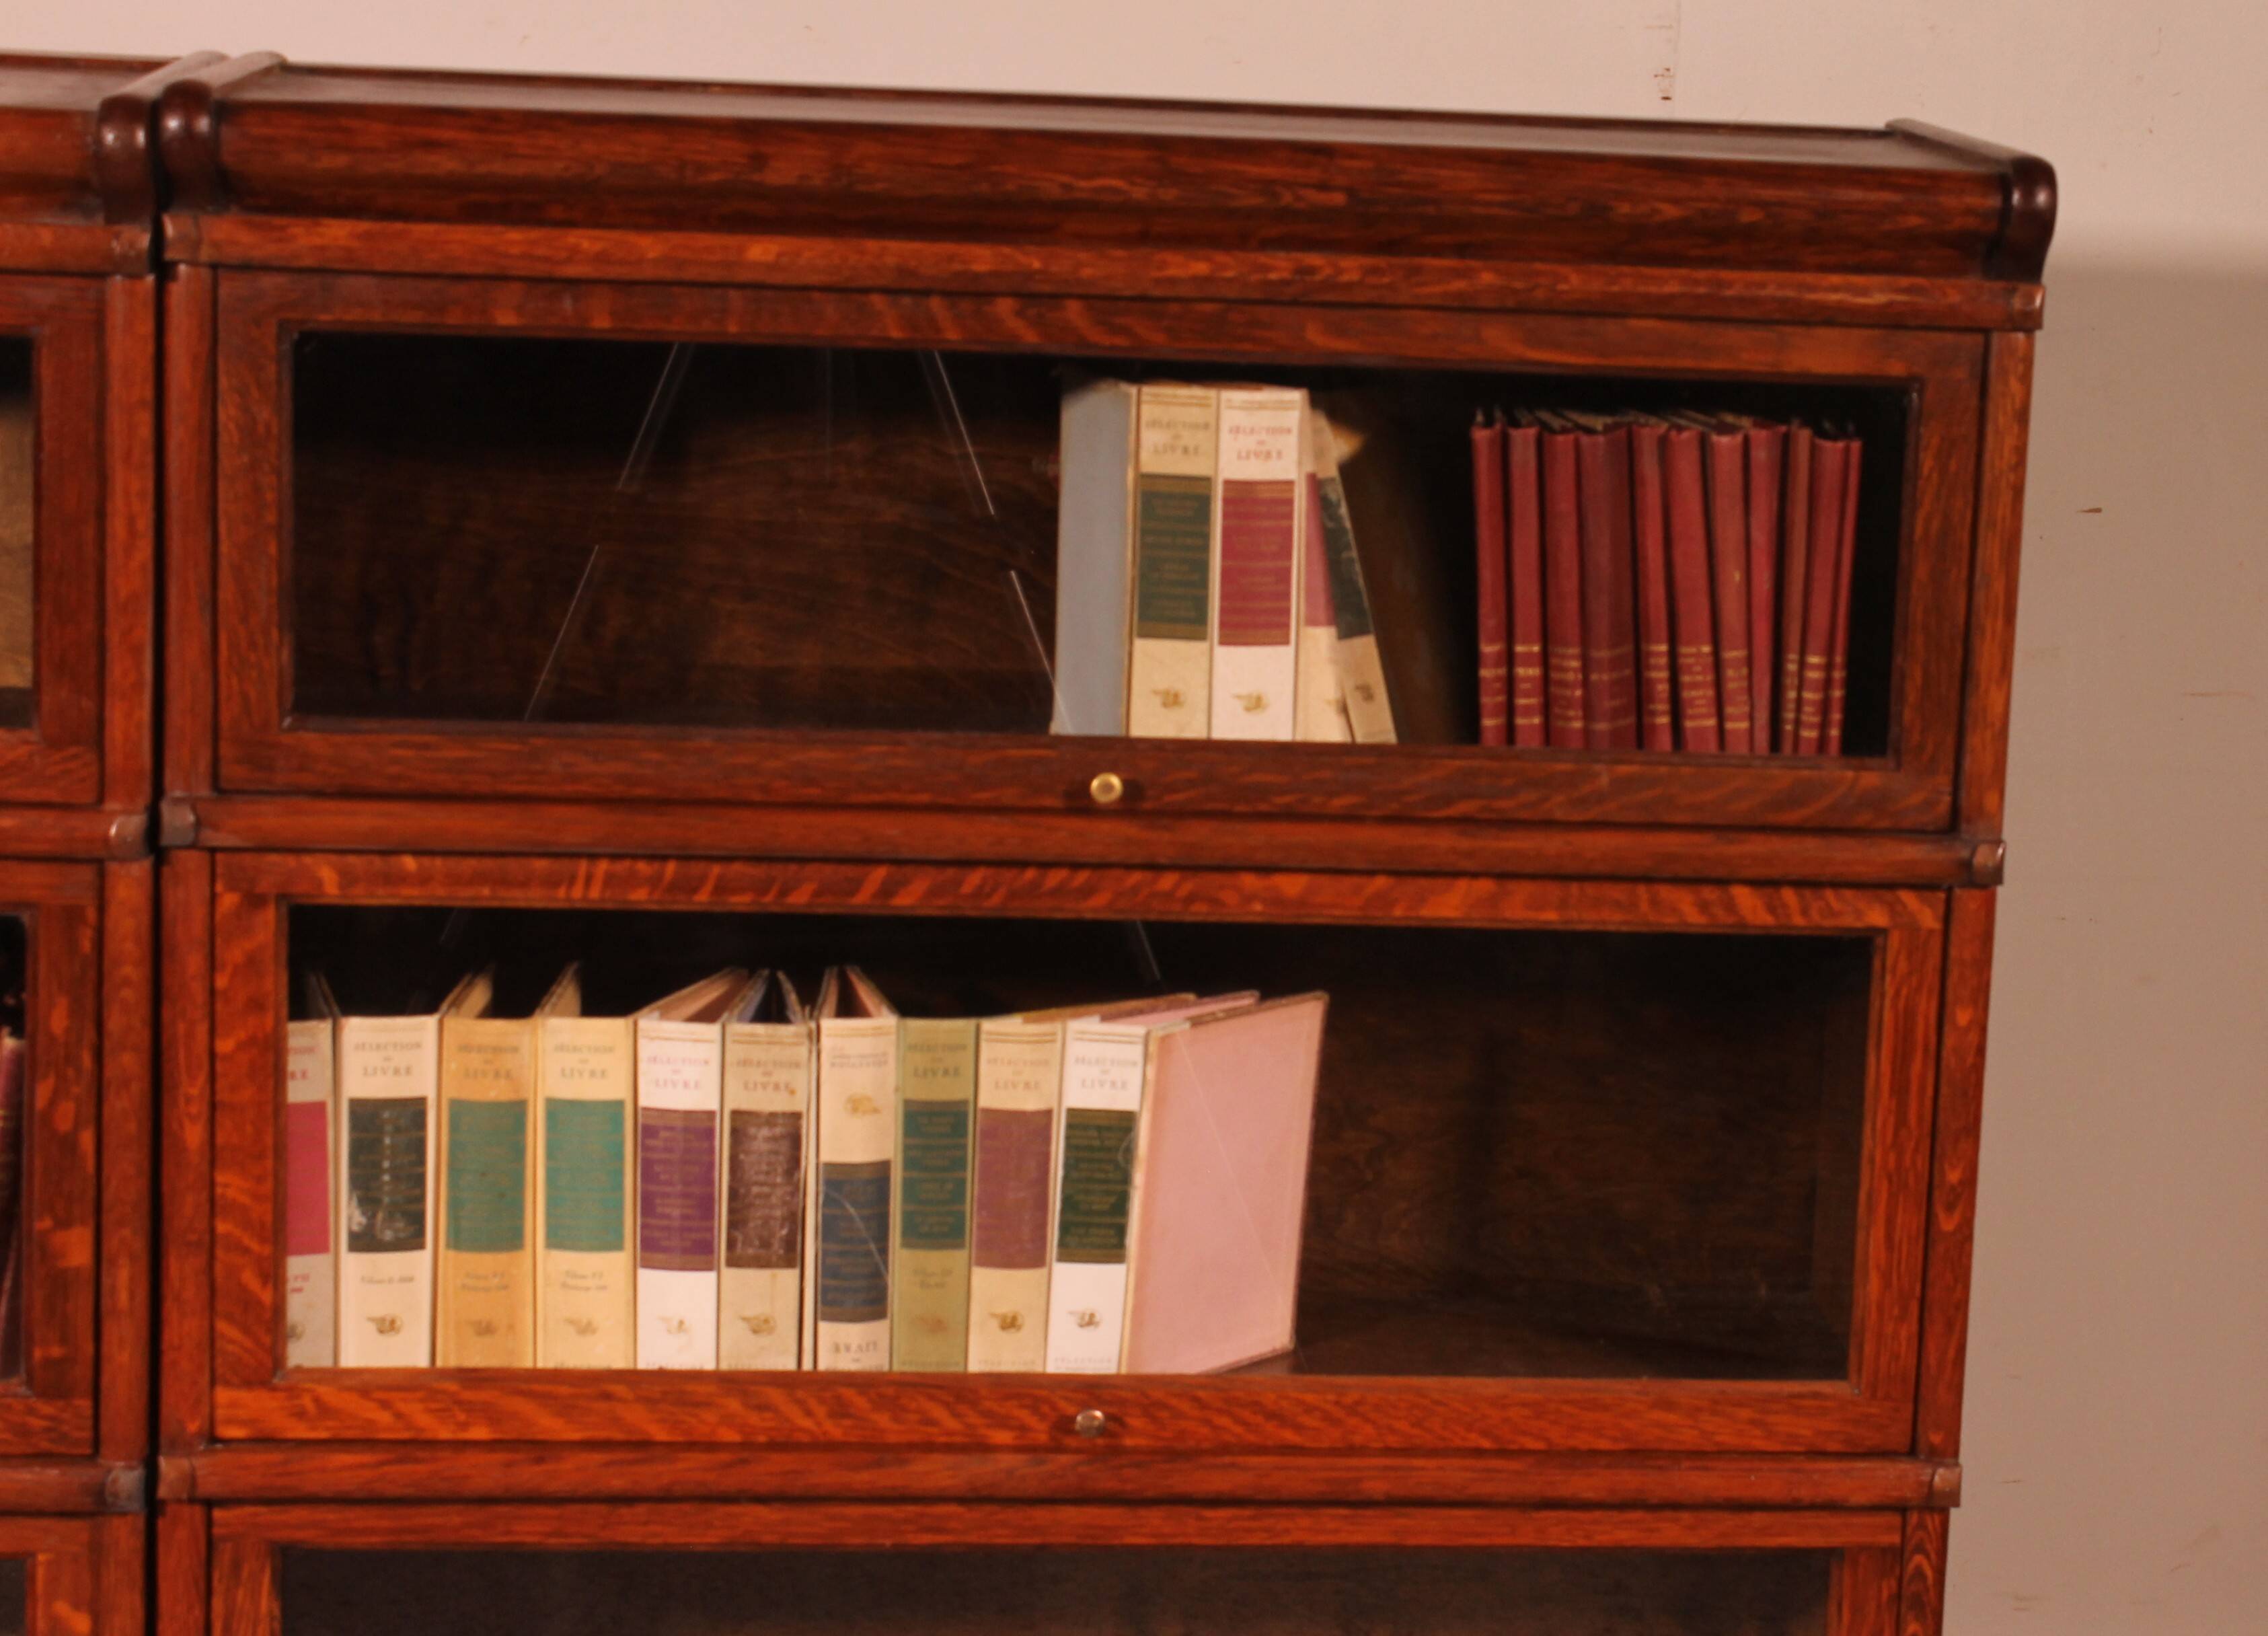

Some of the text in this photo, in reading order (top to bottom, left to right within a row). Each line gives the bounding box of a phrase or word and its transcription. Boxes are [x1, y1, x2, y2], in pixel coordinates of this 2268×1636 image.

[1236, 449, 1283, 461] LIVRE
[362, 1066, 413, 1077] LIVRE
[560, 1068, 608, 1079] LIVRE
[913, 1066, 960, 1078] LIVRE
[654, 1078, 700, 1090] LIVRE
[743, 1081, 791, 1092] LIVRE
[994, 1078, 1040, 1090] LIVRE
[1080, 1078, 1130, 1090] LIVRE
